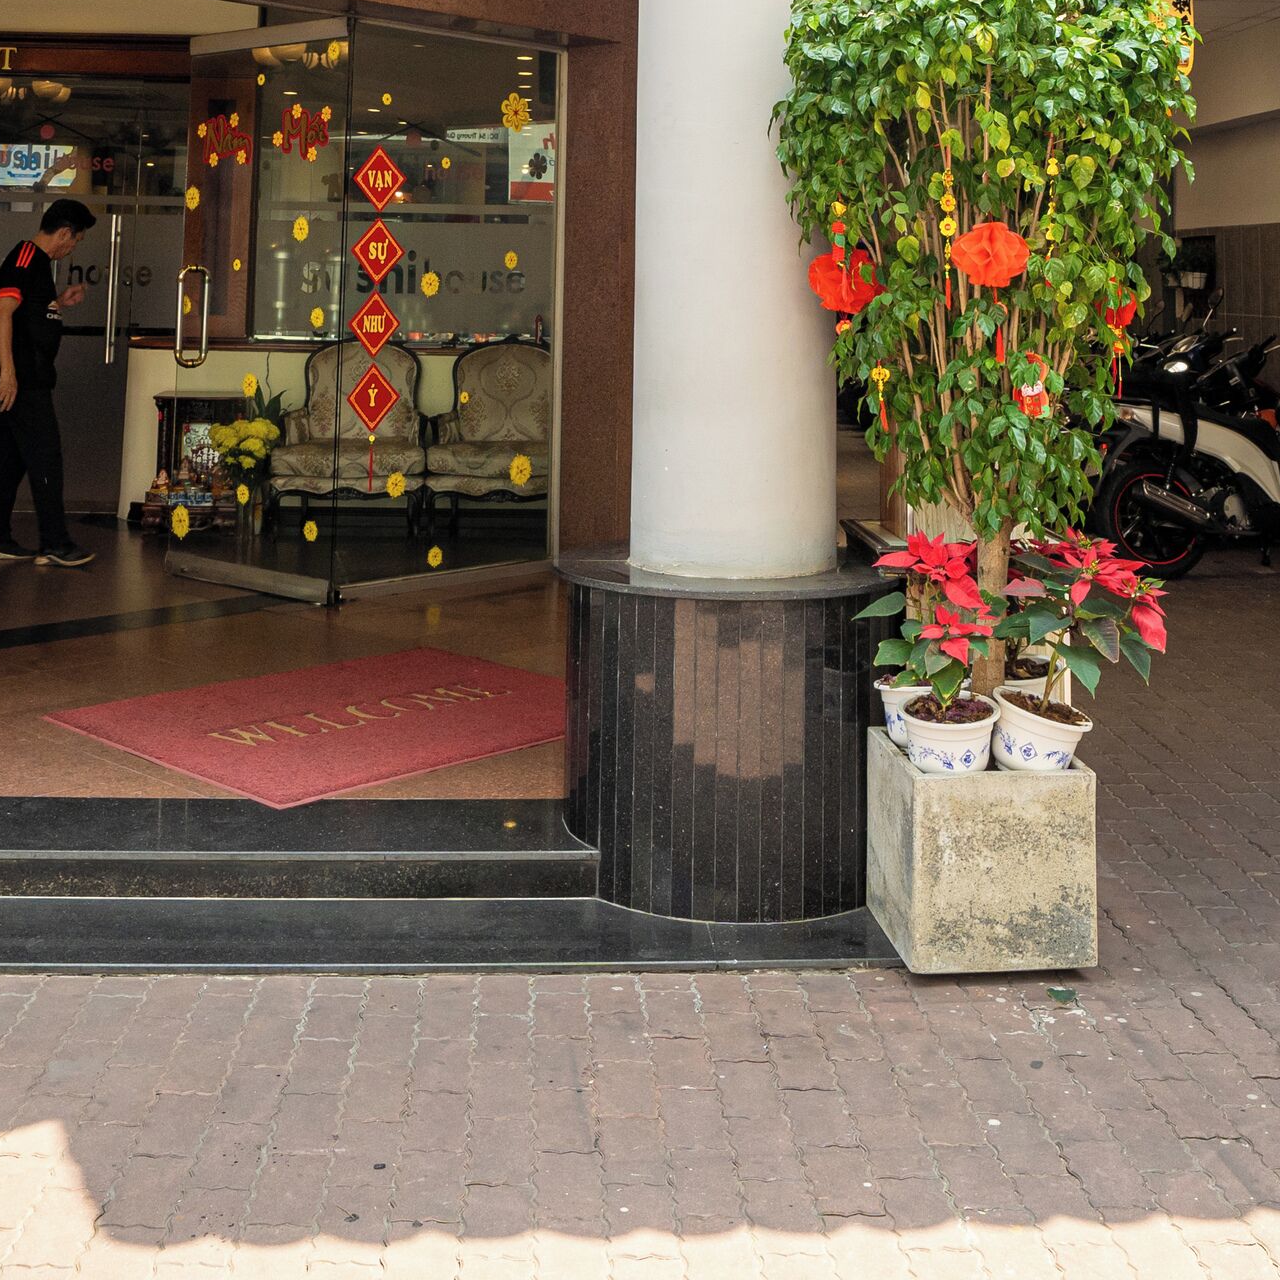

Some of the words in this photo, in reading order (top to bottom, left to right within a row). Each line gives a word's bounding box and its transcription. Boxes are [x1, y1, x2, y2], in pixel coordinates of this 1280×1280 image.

[367, 170, 393, 192] VẠN
[368, 238, 389, 264] SỰ
[362, 311, 387, 333] NHƯ
[367, 383, 379, 407] Ý
[207, 683, 514, 747] WELCOME
